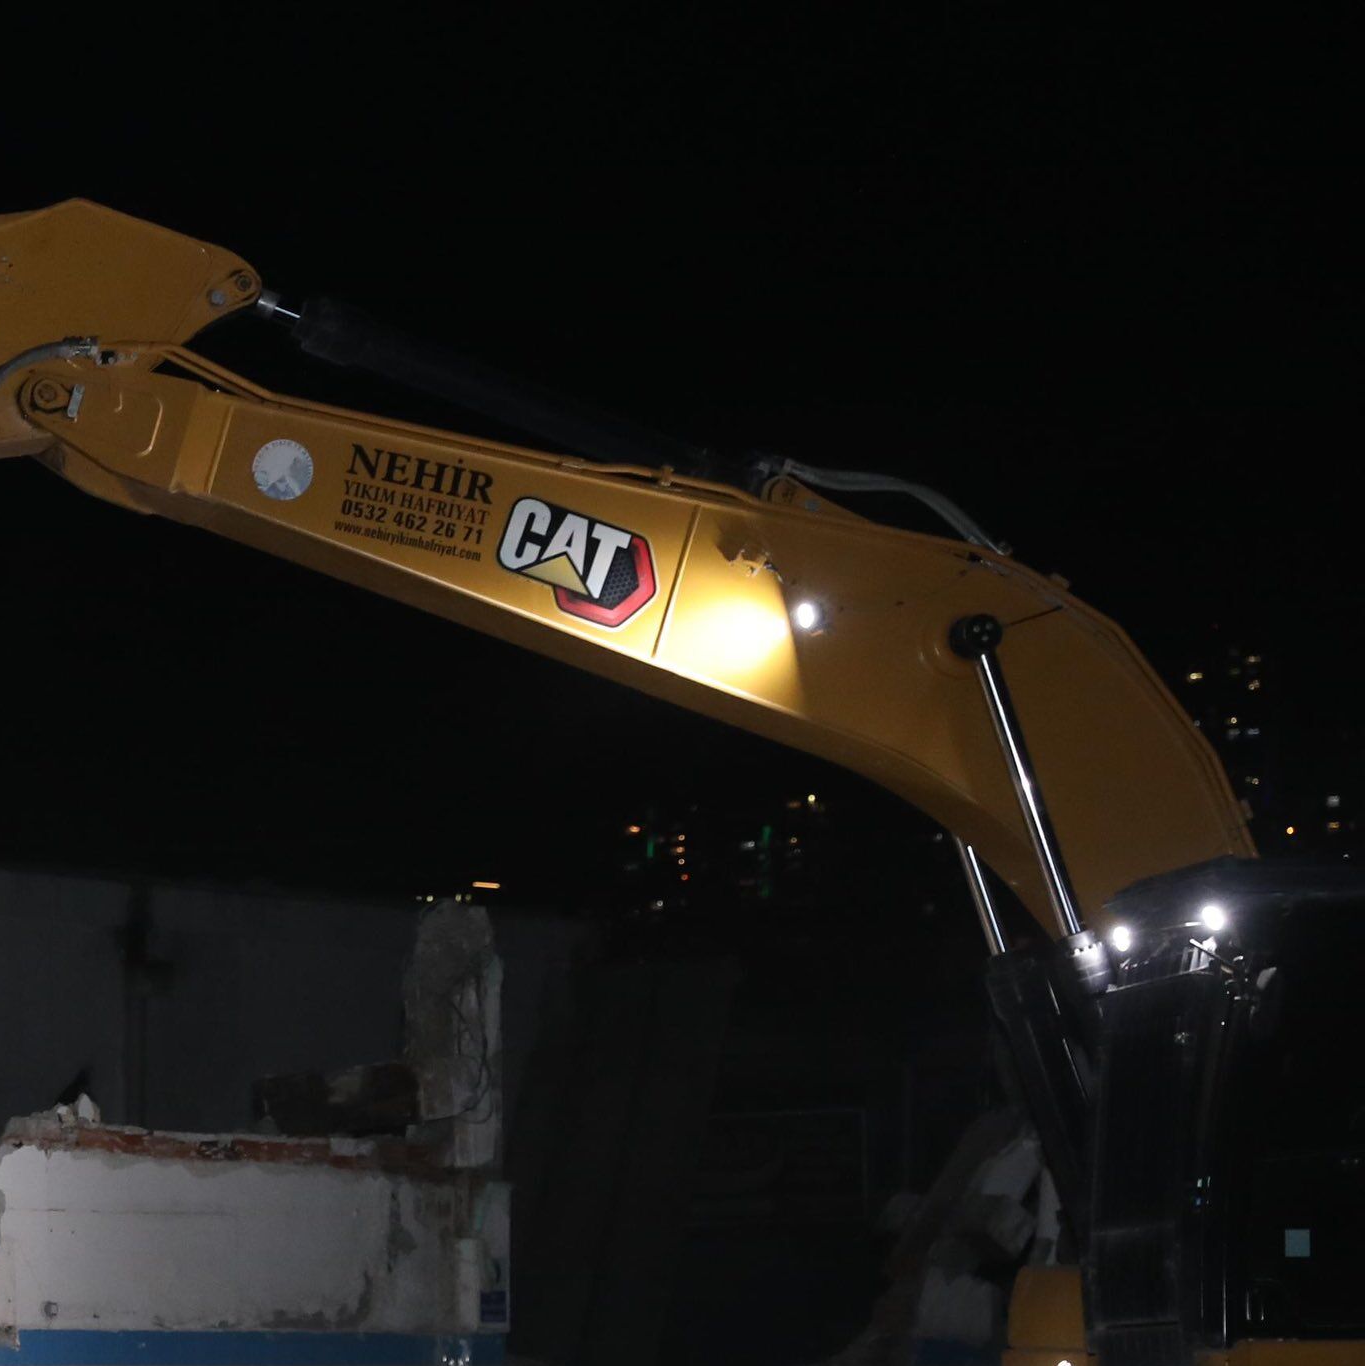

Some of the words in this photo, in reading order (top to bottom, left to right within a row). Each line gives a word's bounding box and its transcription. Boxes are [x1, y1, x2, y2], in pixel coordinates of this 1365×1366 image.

[344, 480, 397, 505] YIKIM
[346, 443, 494, 505] NEHİR
[341, 499, 388, 524] 0532
[393, 510, 428, 533] 462
[433, 519, 456, 539] 26
[463, 525, 485, 545] 71
[499, 497, 632, 600] CAT
